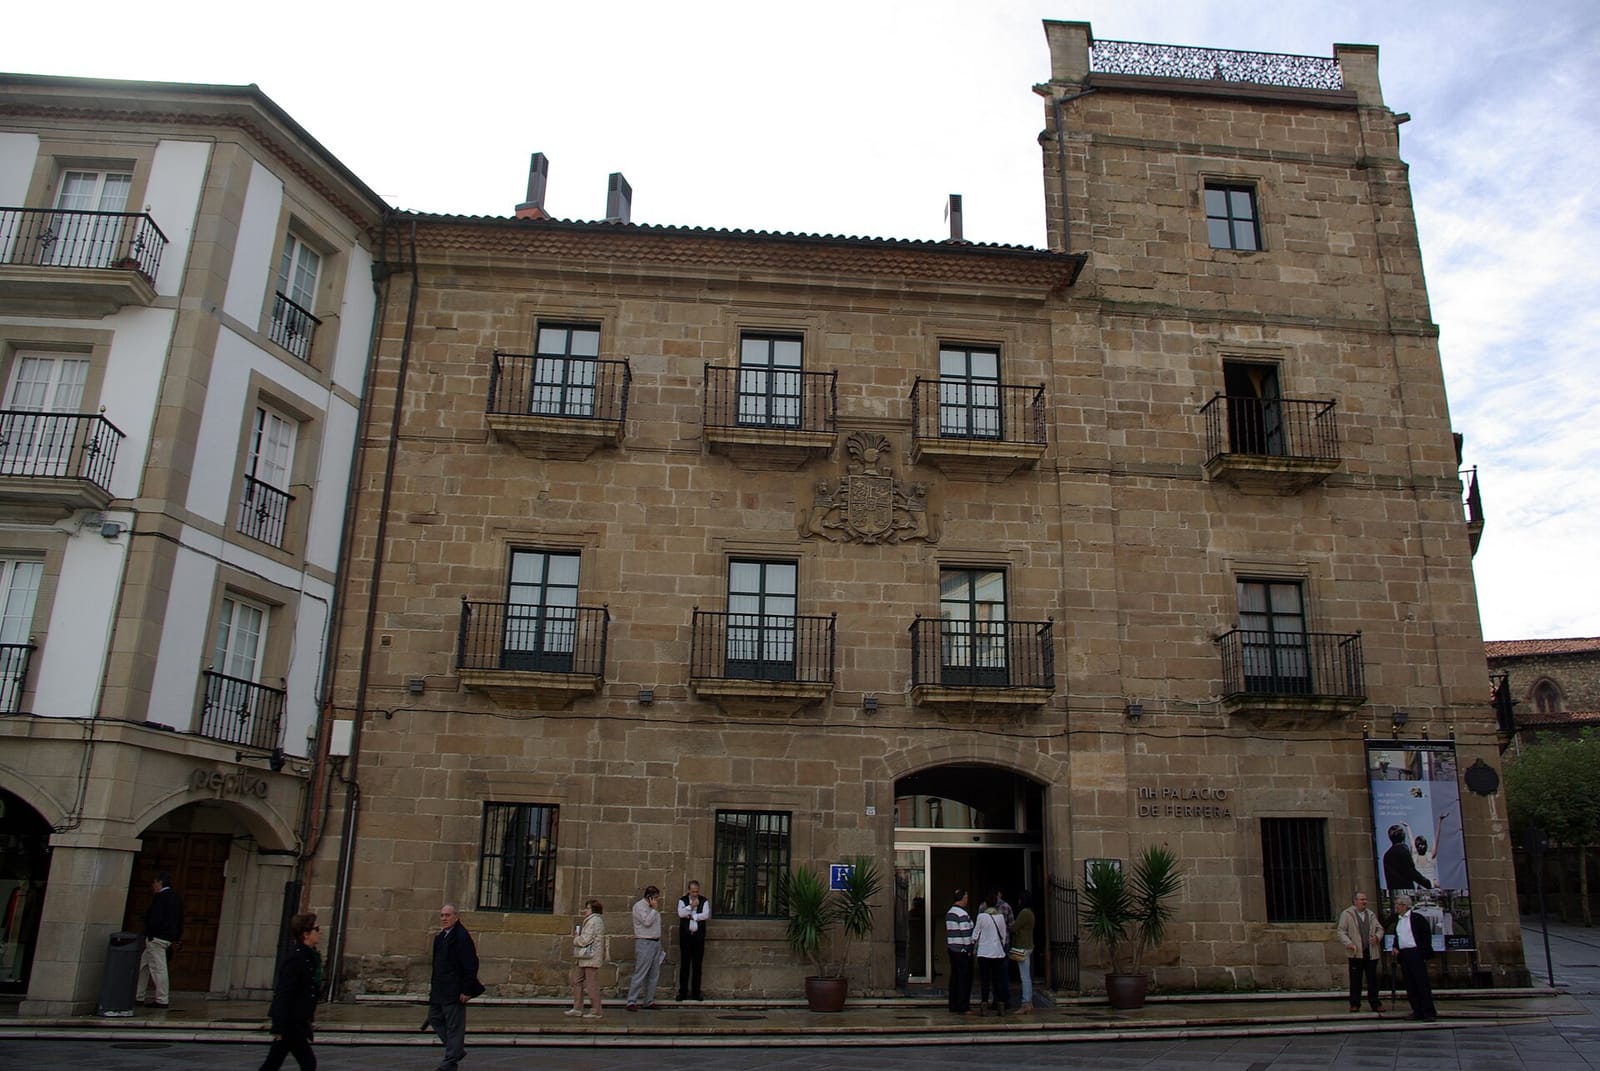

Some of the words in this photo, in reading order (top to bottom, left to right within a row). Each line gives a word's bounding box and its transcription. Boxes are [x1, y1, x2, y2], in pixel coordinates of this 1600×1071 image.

[1162, 787, 1228, 801] PALACIO
[1138, 804, 1160, 818] DE
[1164, 804, 1232, 818] FERRERA
